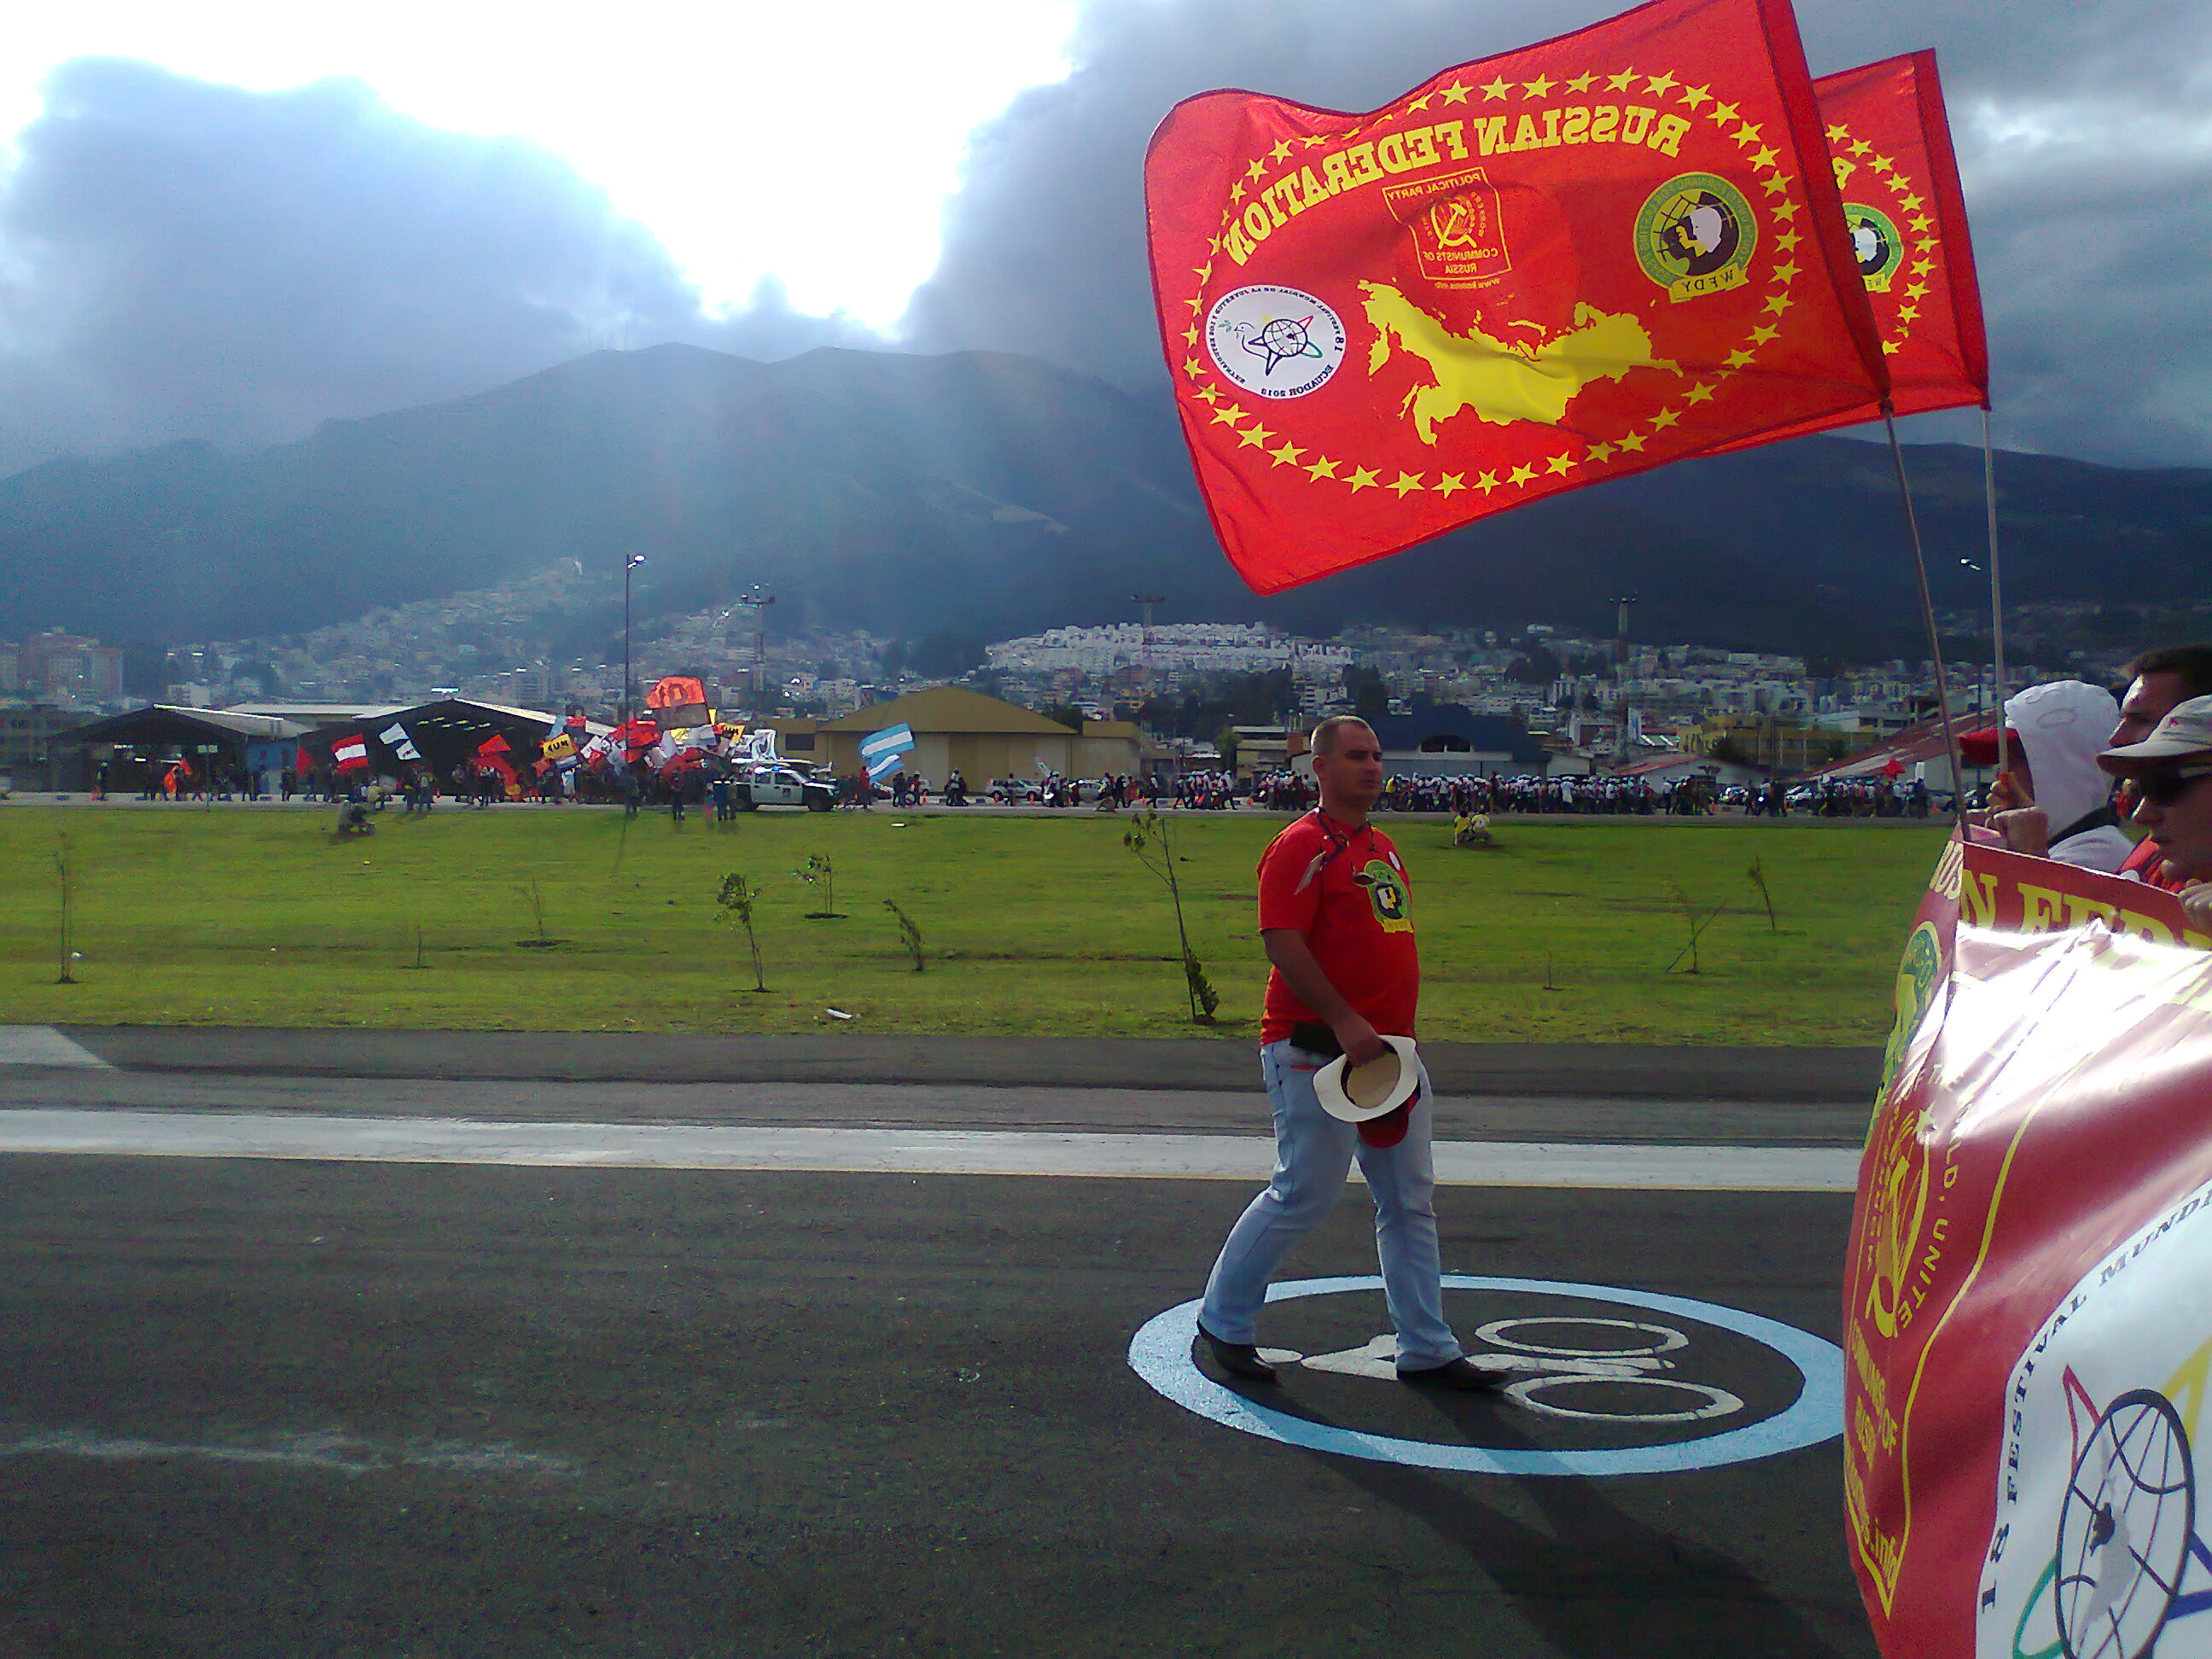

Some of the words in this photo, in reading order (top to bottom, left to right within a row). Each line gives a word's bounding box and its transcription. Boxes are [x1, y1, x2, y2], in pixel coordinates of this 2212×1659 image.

[1897, 1218, 1949, 1330] UNITE
[1982, 1523, 2010, 1615] 18
[2006, 1294, 2087, 1505] FESTIVAL
